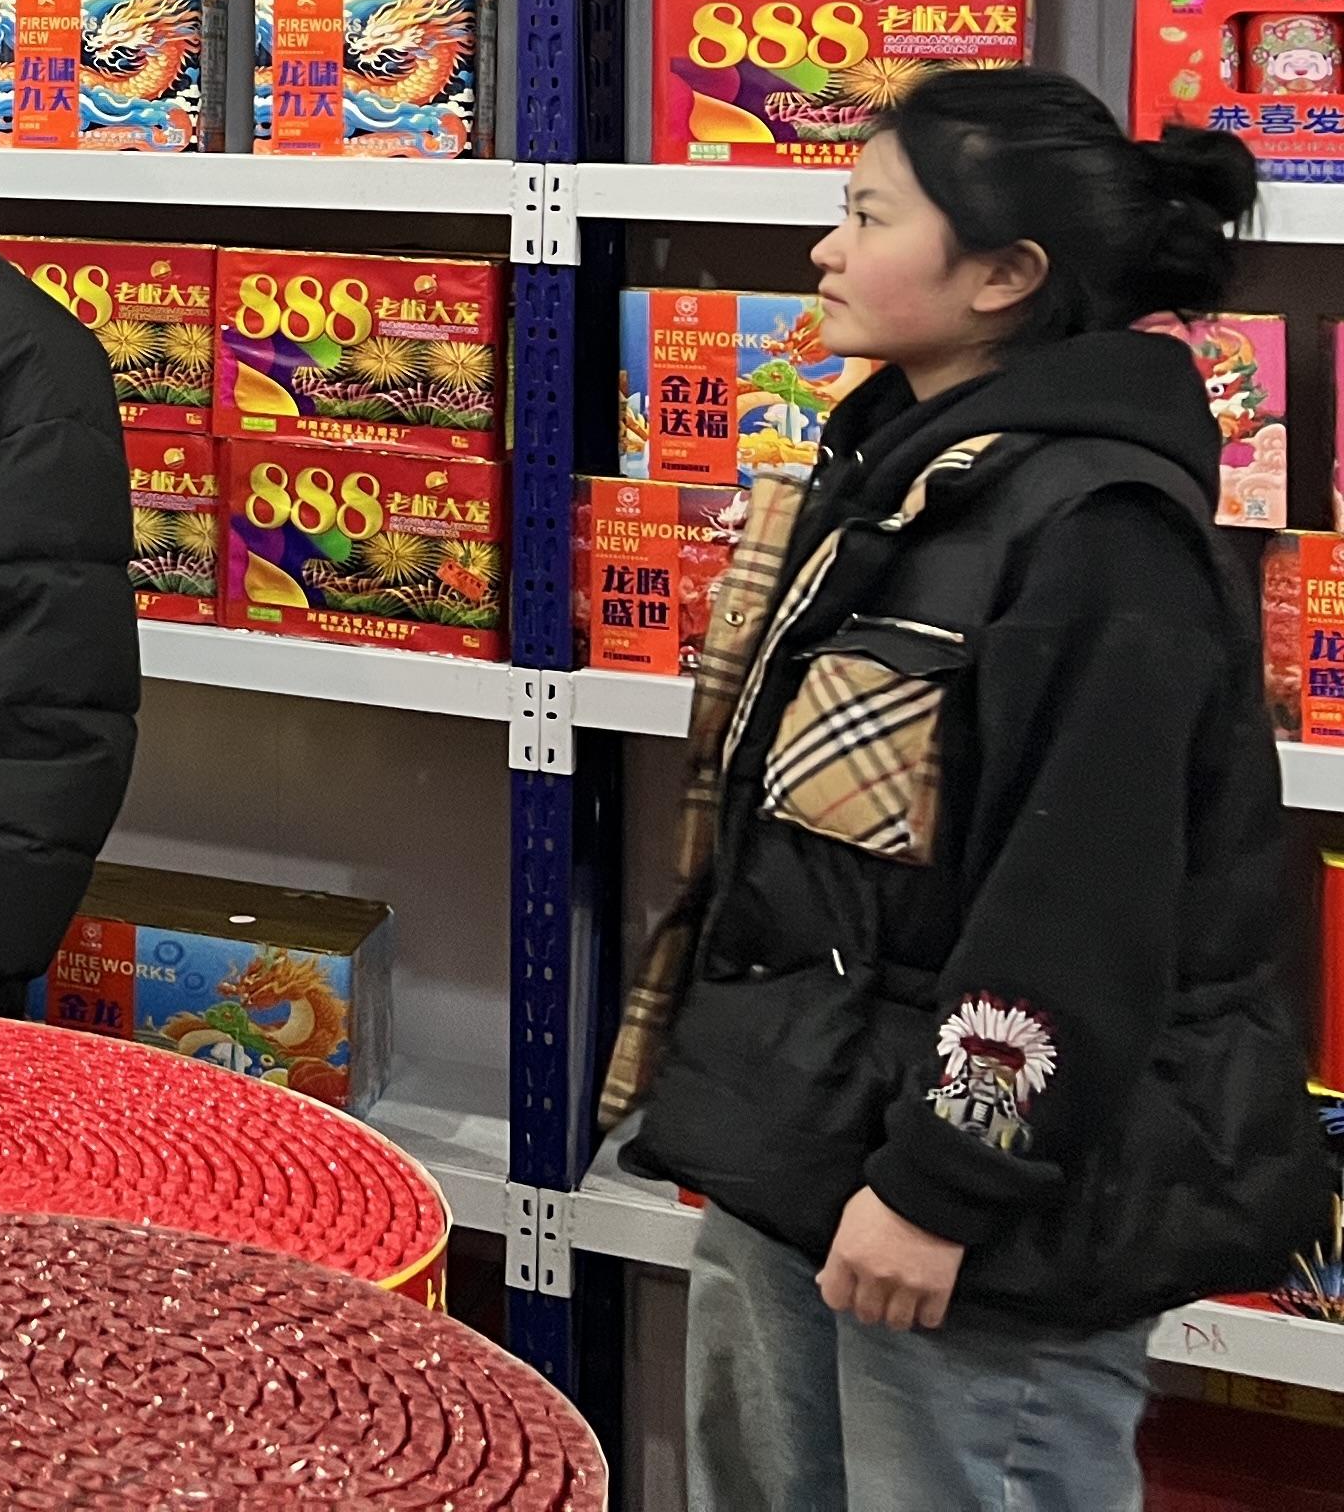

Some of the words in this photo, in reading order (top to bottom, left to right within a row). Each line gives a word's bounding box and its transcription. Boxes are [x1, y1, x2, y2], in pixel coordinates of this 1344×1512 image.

[19, 16, 98, 29] FIREWORKS
[277, 18, 362, 32] FIREWORKS
[877, 4, 1016, 34] 老板大发
[19, 32, 49, 44] NEW
[277, 33, 309, 47] NEW
[689, 2, 868, 69] 888
[9, 261, 113, 330] 88
[114, 282, 211, 307] 老板大发
[234, 274, 373, 347] 888
[374, 296, 482, 326] 老板大发
[654, 330, 772, 349] FIREWORKS
[654, 346, 698, 362] NEW
[660, 375, 728, 406] 金龙
[659, 408, 729, 439] 送福
[245, 462, 384, 539] 888
[385, 491, 490, 524] 老板大发
[596, 519, 714, 543] FIREWORKS
[596, 536, 640, 553] NEW
[601, 564, 671, 597] 龙腾
[601, 598, 670, 631] 盛世
[56, 965, 101, 985] NEW
[57, 949, 177, 983] FIREWORKS
